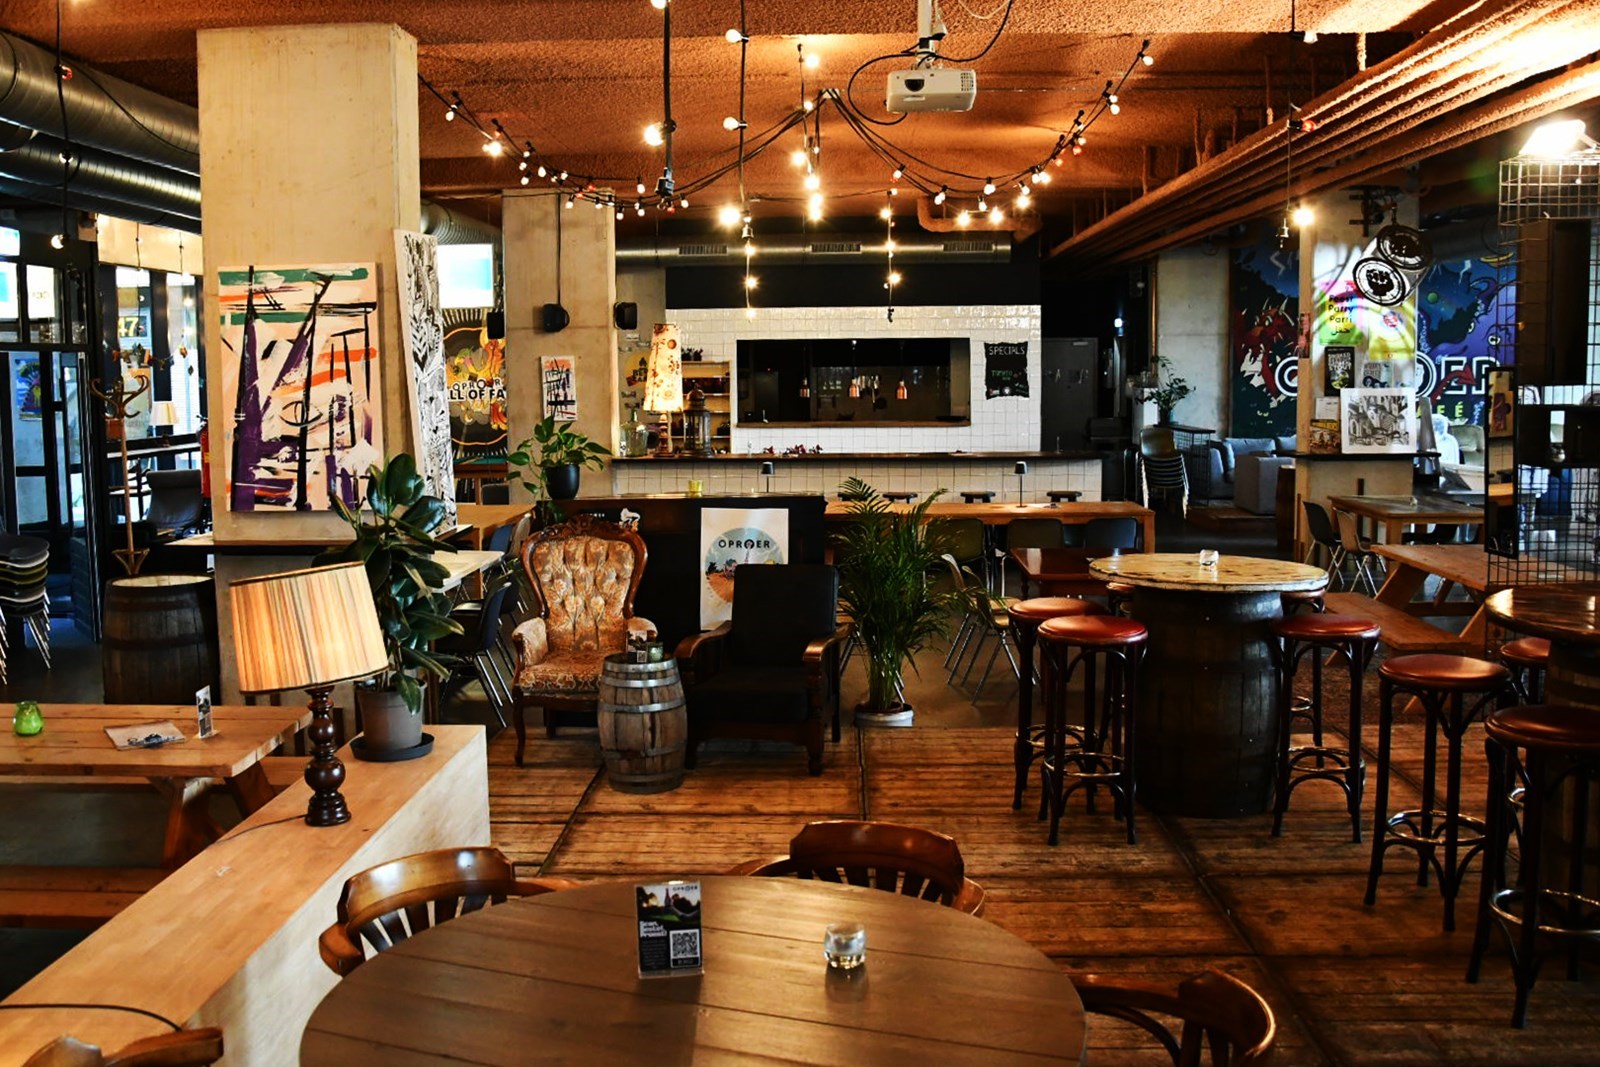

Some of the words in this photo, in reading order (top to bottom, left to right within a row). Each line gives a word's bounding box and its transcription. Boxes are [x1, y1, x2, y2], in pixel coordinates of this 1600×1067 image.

[1328, 304, 1353, 314] Party
[988, 345, 1025, 356] SPECIALS
[452, 378, 501, 391] OPROR
[468, 389, 485, 400] OF
[489, 389, 505, 400] FA
[718, 538, 770, 549] OPROER
